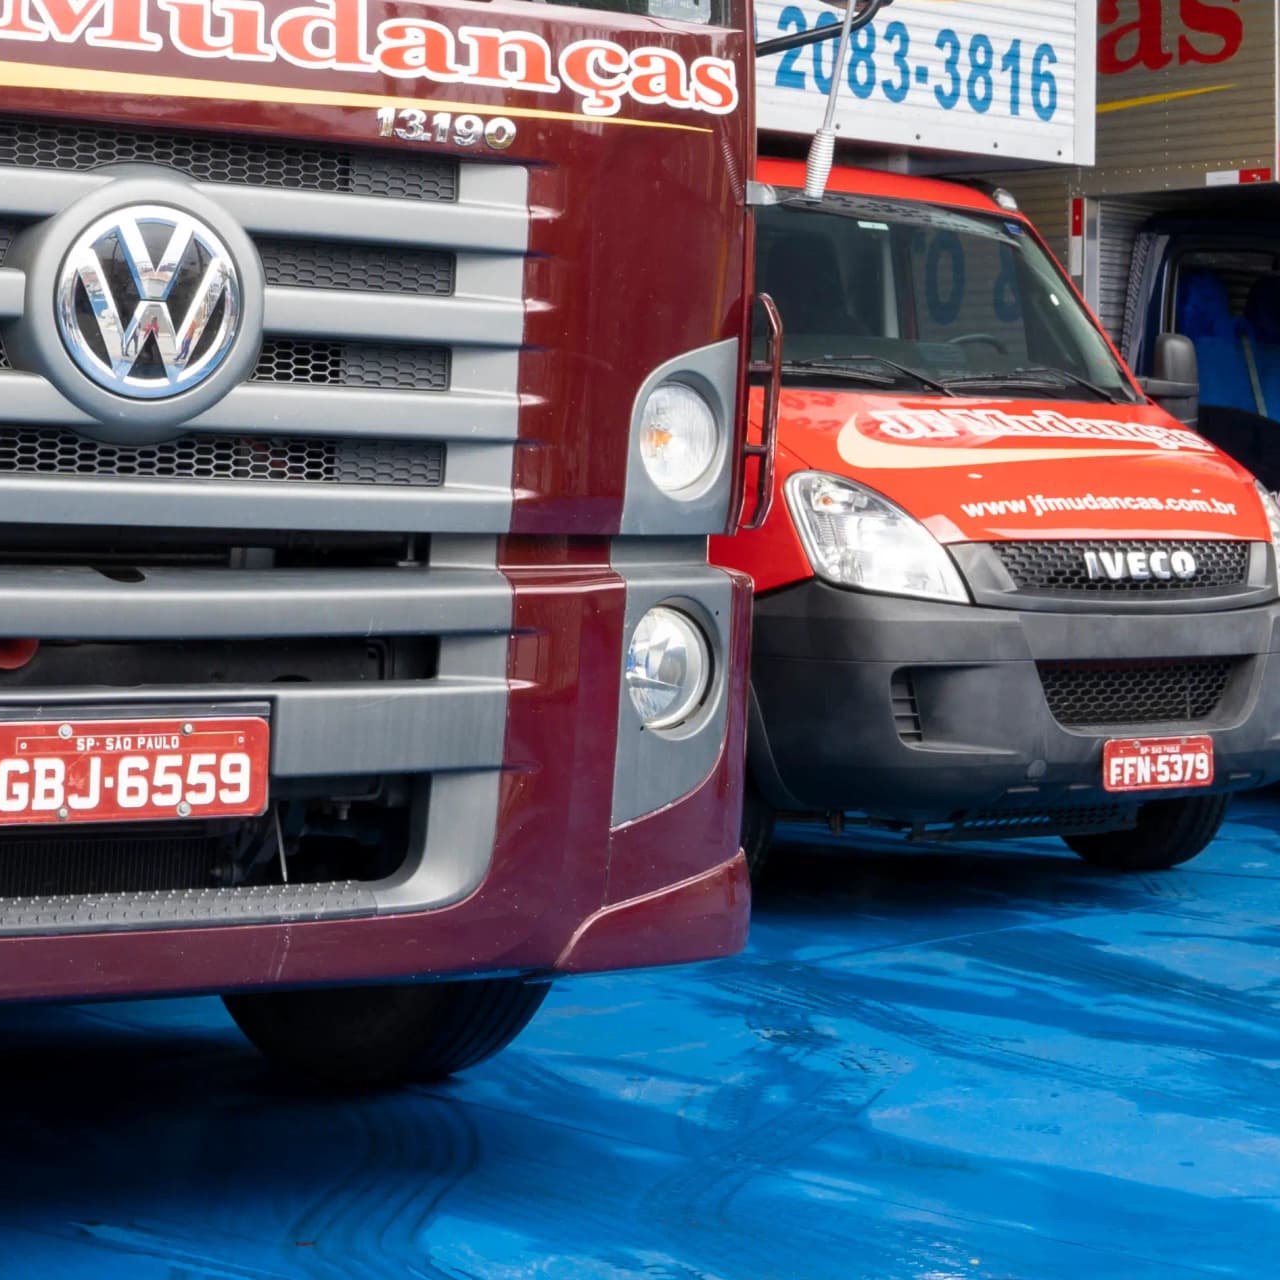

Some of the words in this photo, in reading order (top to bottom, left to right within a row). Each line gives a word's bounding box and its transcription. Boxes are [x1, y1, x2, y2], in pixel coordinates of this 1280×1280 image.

[775, 5, 1058, 122] 2083-3816
[376, 106, 518, 151] 13.190
[1083, 551, 1197, 580] IVECO
[137, 735, 180, 750] PAULO
